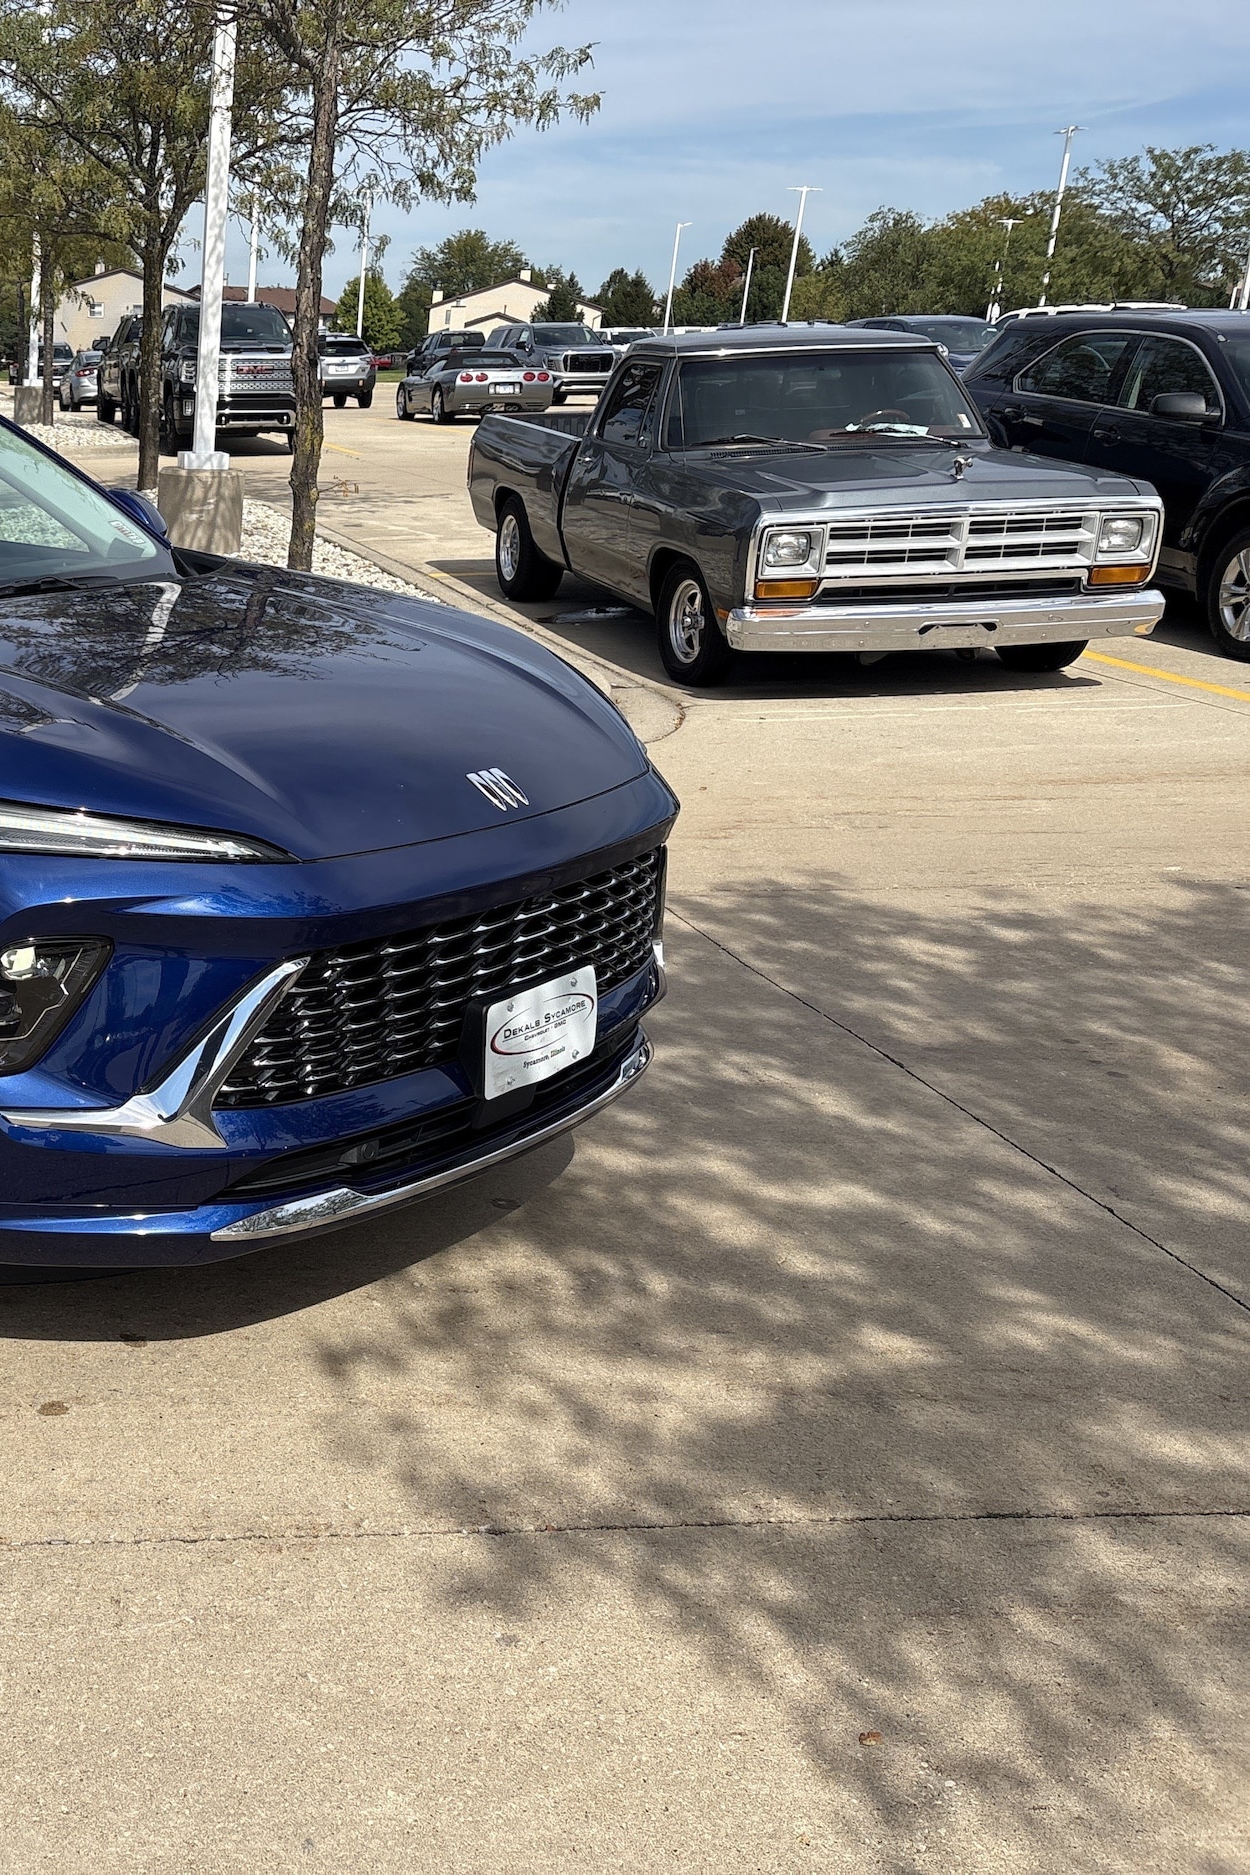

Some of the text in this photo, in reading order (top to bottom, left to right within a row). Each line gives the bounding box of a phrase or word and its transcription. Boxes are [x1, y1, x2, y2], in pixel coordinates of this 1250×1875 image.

[237, 365, 274, 374] GMC
[544, 1000, 586, 1023] SYCAMORE
[554, 1019, 567, 1029] GMC
